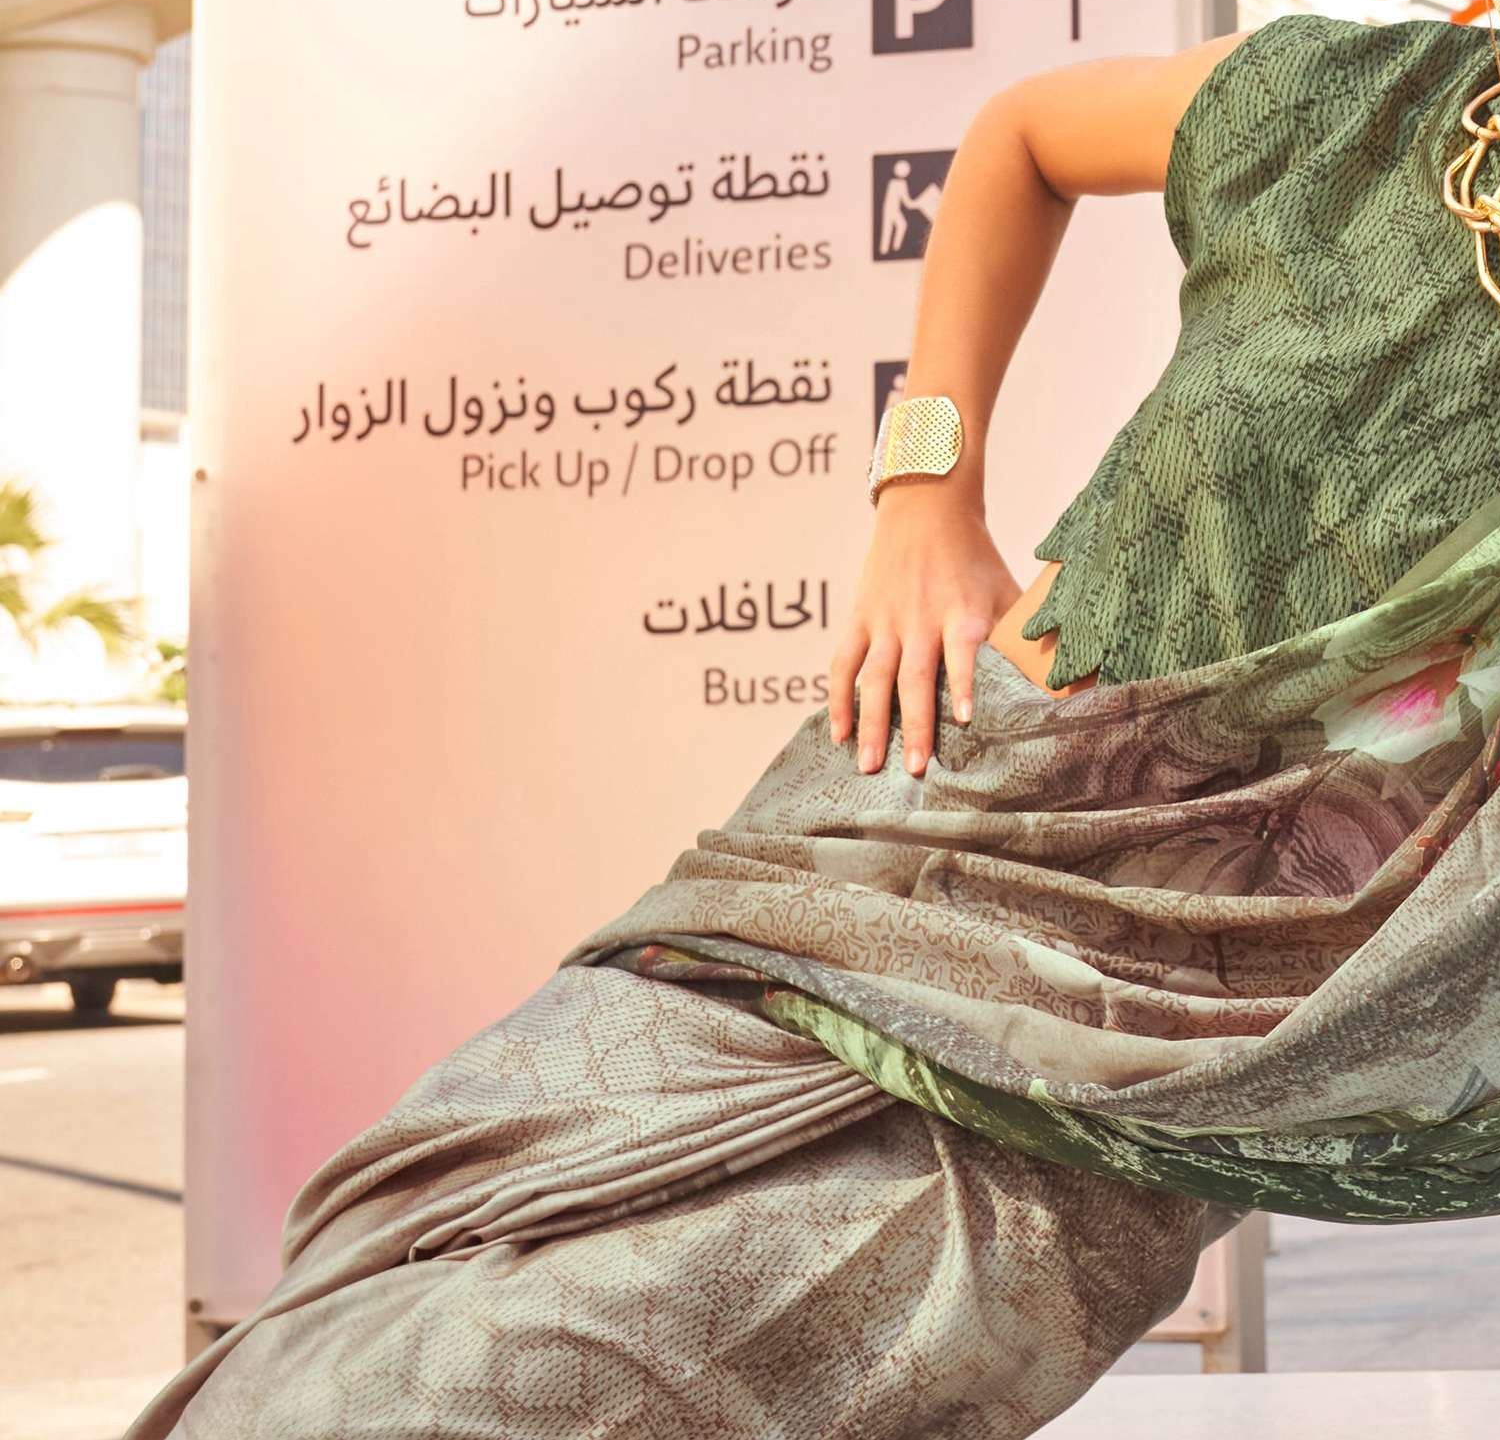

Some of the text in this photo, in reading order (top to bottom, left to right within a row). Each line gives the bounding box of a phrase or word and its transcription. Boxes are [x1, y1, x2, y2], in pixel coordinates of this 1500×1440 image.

[677, 28, 832, 73] Parking
[347, 153, 830, 249] نقطة توصيل البضائع
[624, 234, 832, 280] Deliveries
[293, 360, 832, 443] نقطة ركوب ونزول الزوار
[462, 432, 838, 498] Pick Up / Drop Off
[643, 578, 828, 635] الحافلات
[704, 667, 830, 706] Buses
